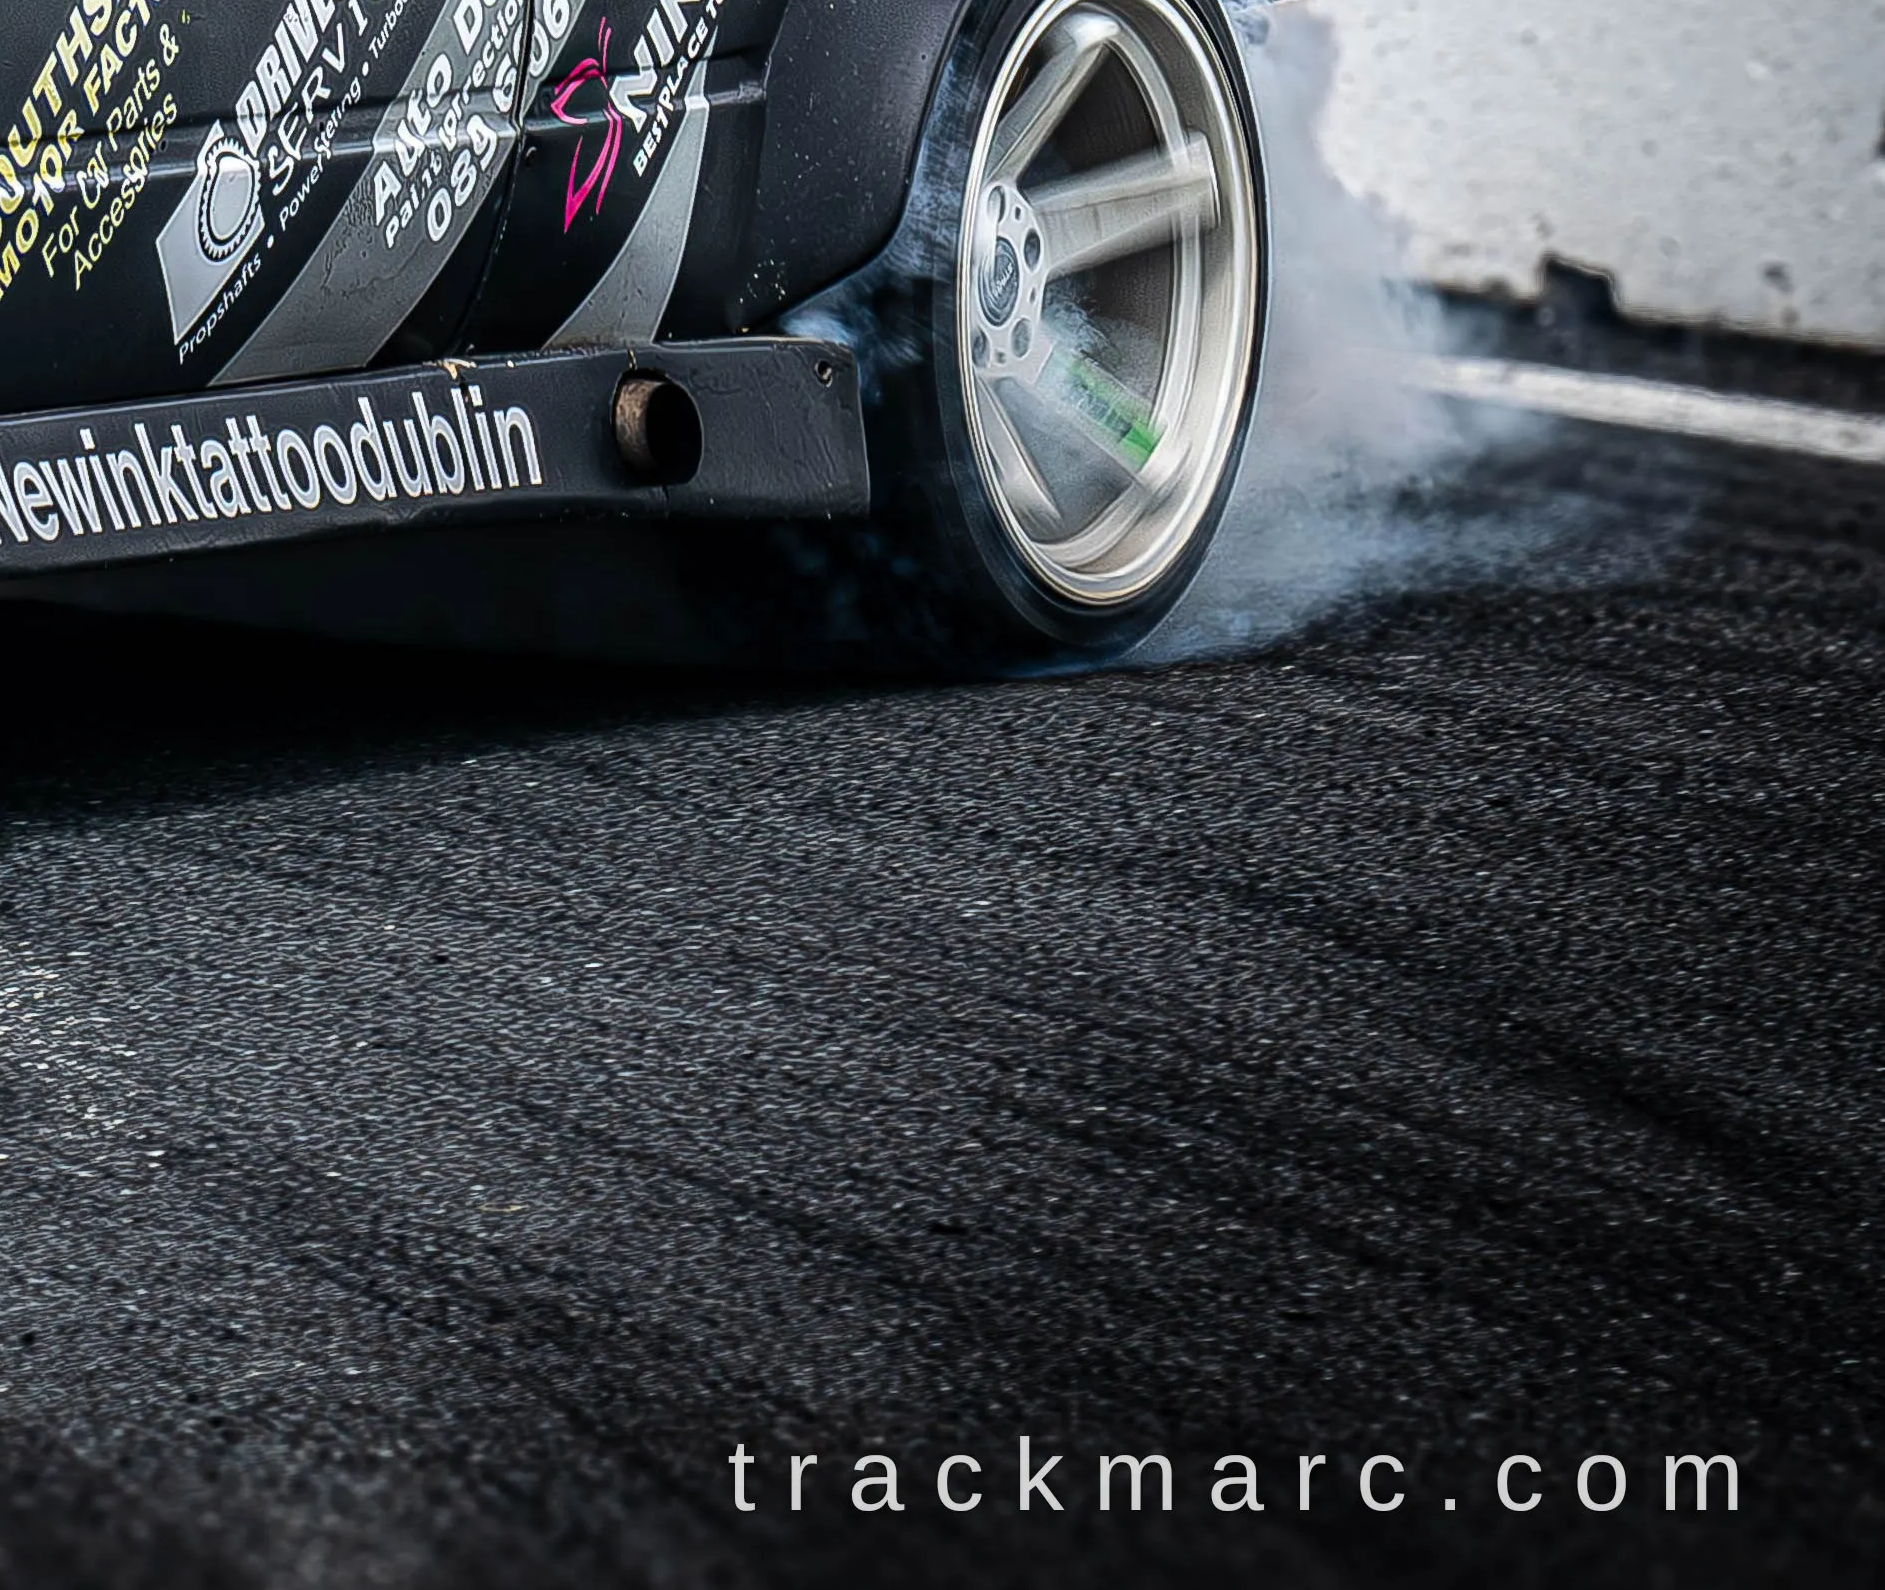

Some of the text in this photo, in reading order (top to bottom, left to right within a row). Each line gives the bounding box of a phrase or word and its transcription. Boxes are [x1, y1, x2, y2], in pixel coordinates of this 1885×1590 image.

[41, 204, 81, 279] For
[106, 56, 161, 153] Parts
[159, 22, 180, 67] &
[372, 53, 454, 227] Auto
[426, 114, 498, 242] 089
[632, 106, 674, 178] BEST
[660, 9, 709, 111] PLACE
[72, 92, 178, 291] Accessories
[179, 252, 262, 365] Propshafts
